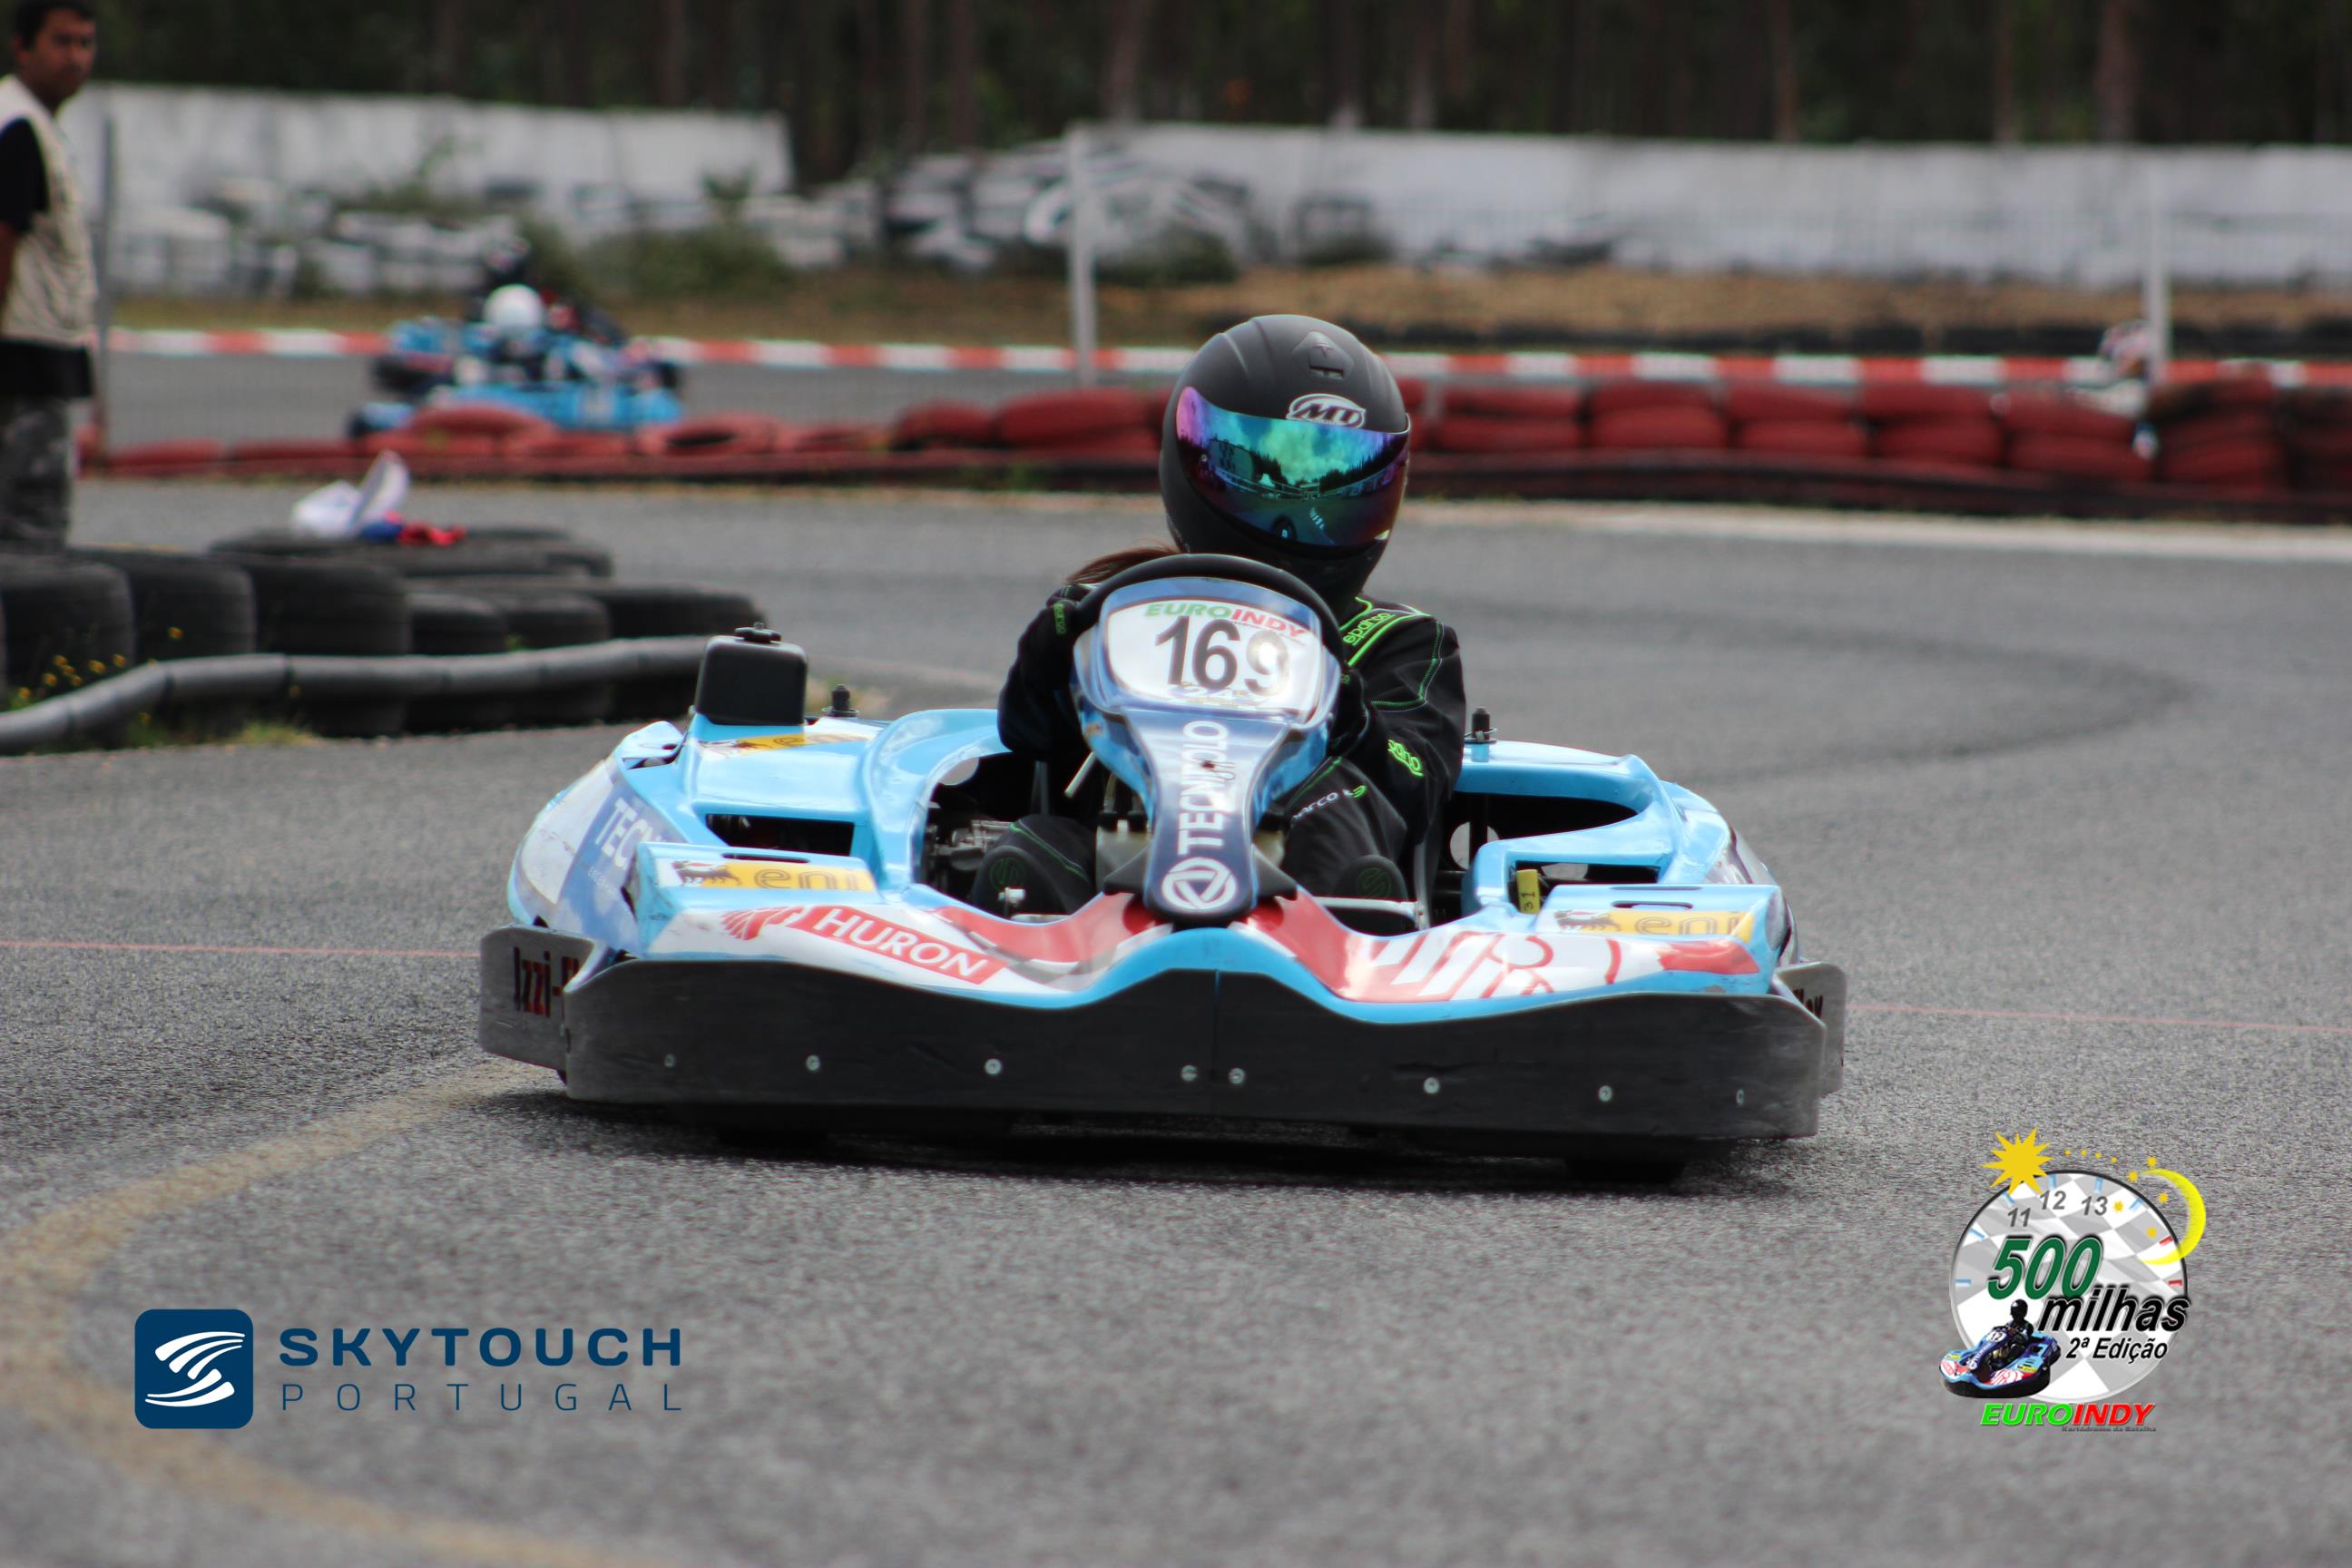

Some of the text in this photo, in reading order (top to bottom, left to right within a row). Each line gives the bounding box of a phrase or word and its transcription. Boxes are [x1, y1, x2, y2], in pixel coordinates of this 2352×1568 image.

[1288, 399, 1363, 428] MT
[1154, 615, 1290, 696] 169
[754, 868, 859, 890] eni
[1634, 911, 1740, 936] eni
[813, 907, 988, 977] HURON
